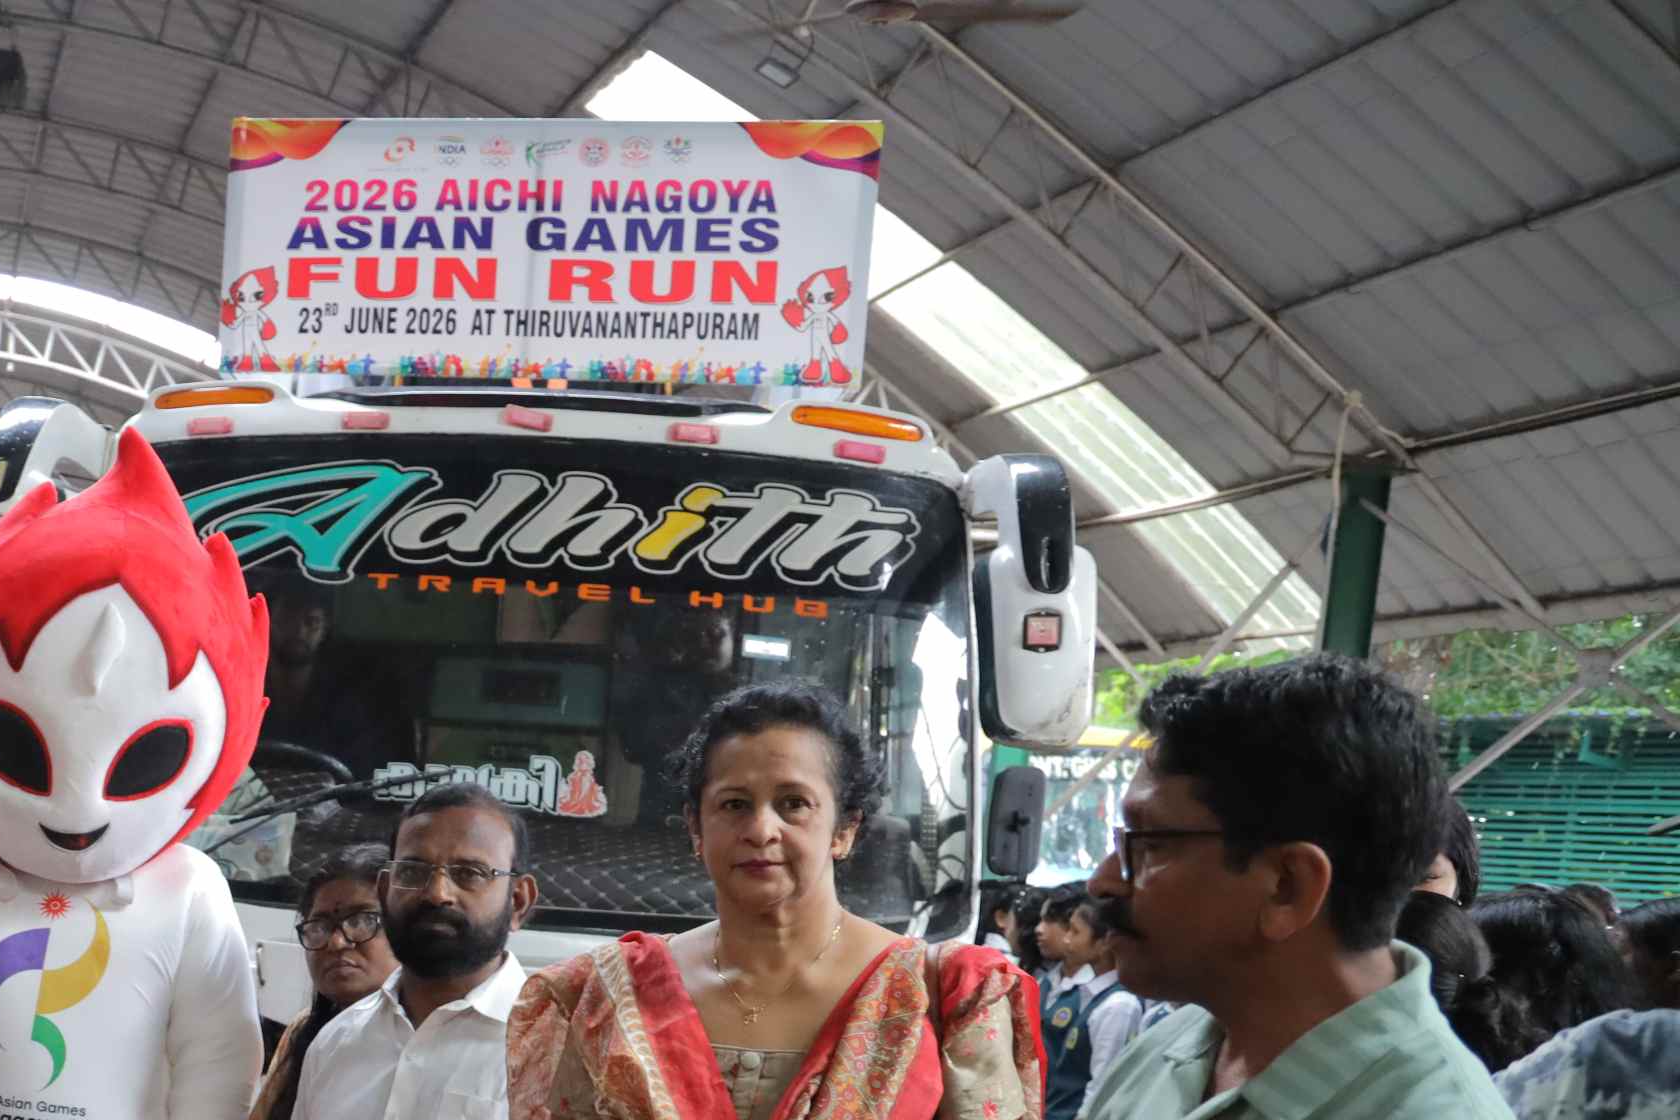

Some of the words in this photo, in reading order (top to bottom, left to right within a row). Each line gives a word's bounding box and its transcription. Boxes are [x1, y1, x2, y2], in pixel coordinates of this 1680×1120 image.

[304, 178, 417, 212] 2026
[435, 178, 563, 212] AICHI
[590, 179, 778, 213] NAGOYA
[286, 216, 494, 250] ASIAN
[526, 216, 781, 253] GAMES
[287, 257, 498, 301] FUN
[548, 259, 778, 304] RUN
[344, 307, 398, 334] JUNE
[405, 307, 457, 335] 2026
[471, 309, 496, 336] AT
[504, 309, 760, 341] THIRUVANANTHAPURAM
[367, 572, 656, 605] TRAVEL
[689, 590, 830, 619] HUB
[36, 1100, 87, 1117] Games
